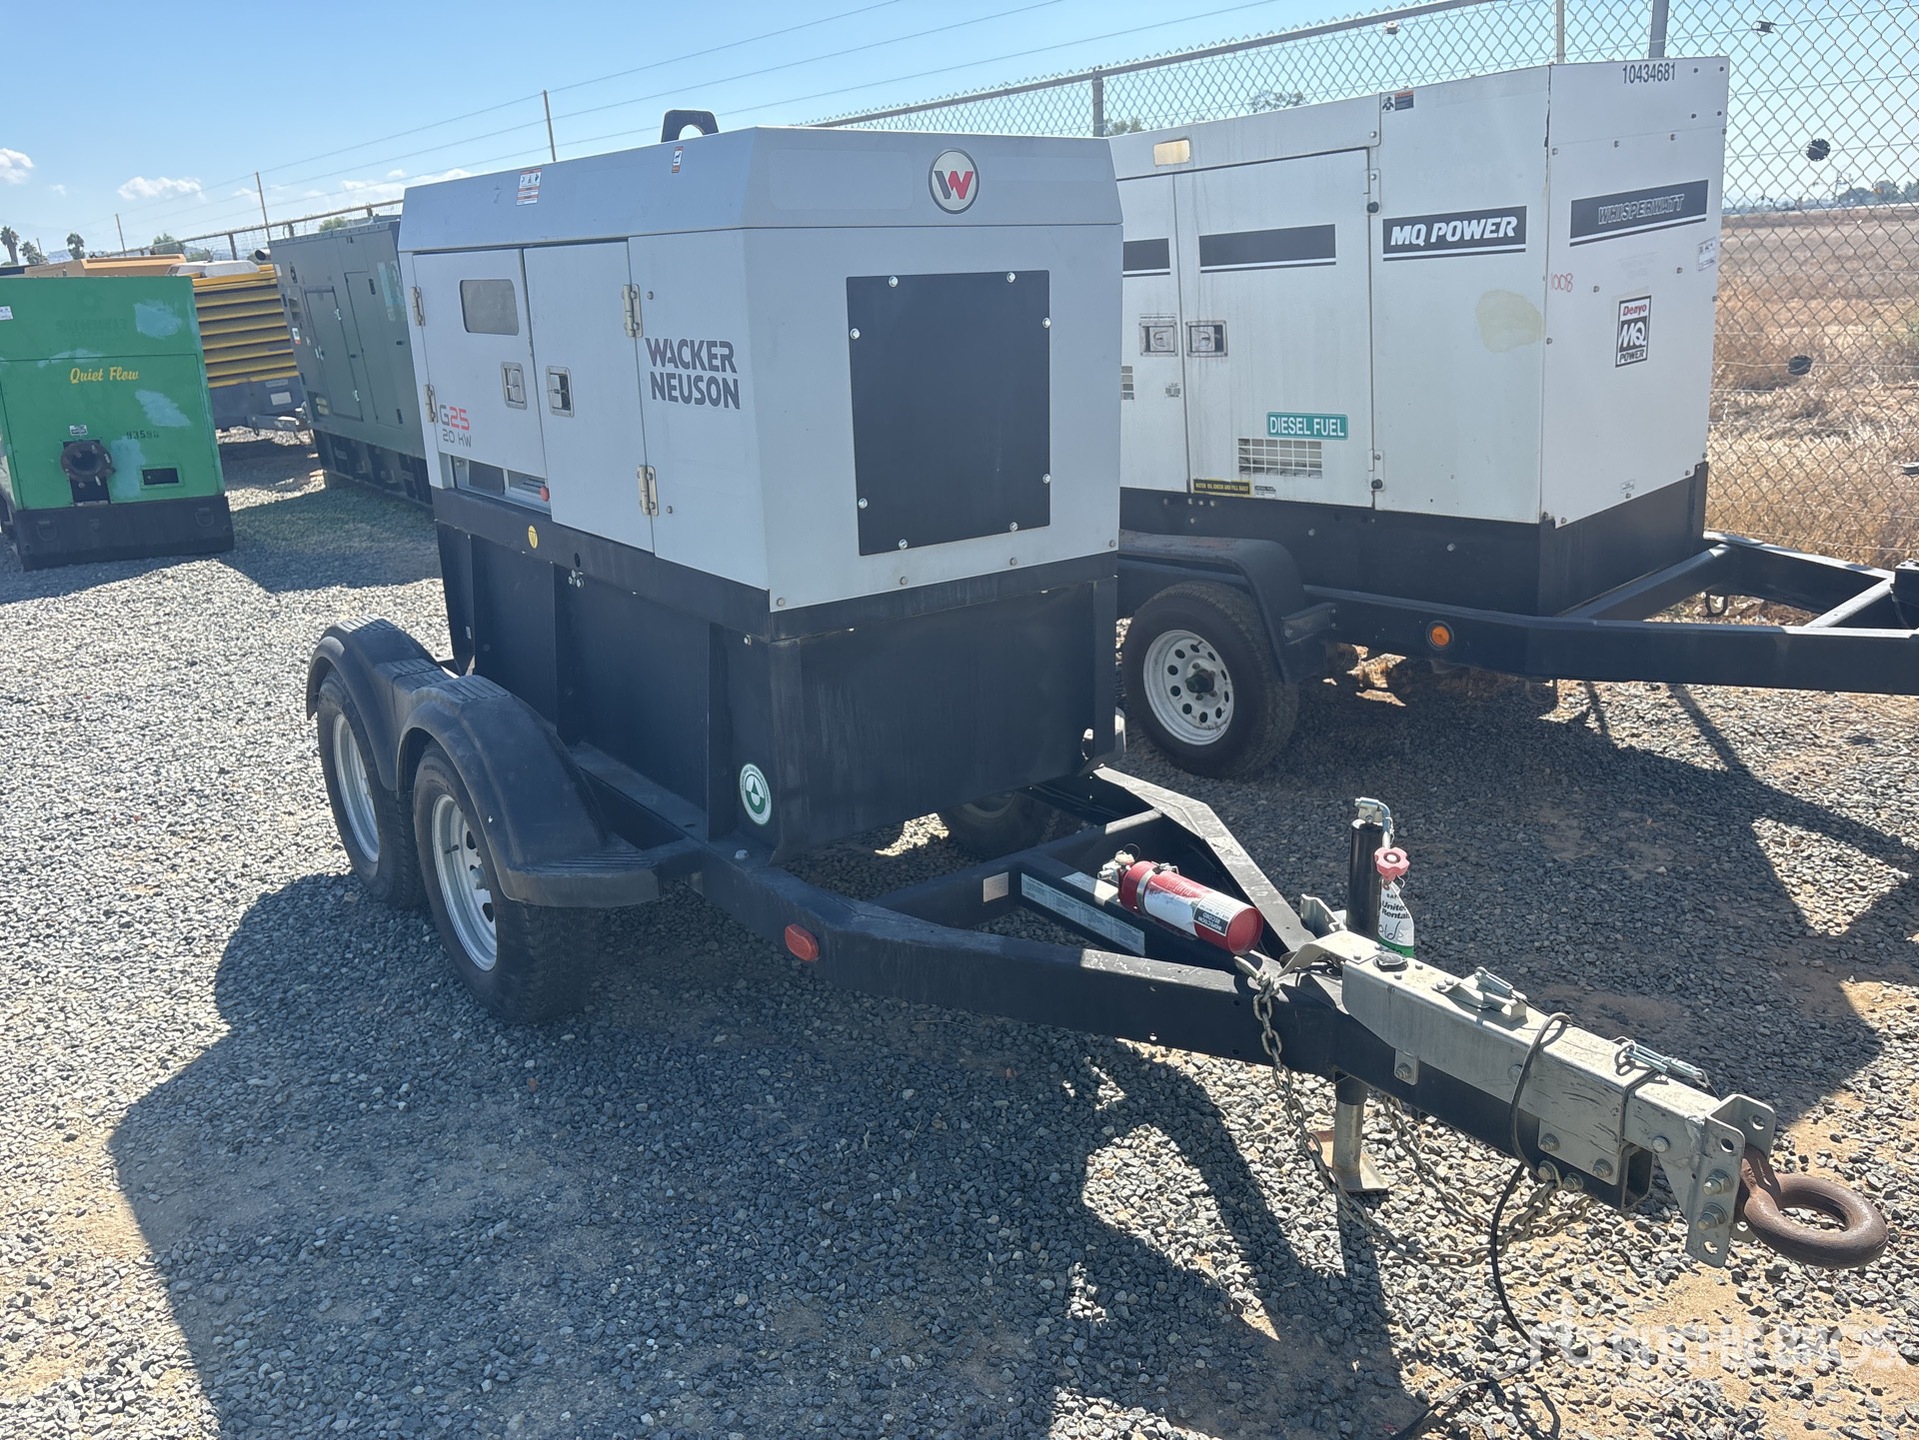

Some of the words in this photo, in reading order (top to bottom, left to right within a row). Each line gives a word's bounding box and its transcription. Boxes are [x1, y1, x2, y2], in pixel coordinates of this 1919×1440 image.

[1622, 62, 1676, 84] 10434681
[1597, 193, 1685, 225] WHISPERWATT
[1390, 223, 1427, 246] MQ
[1430, 216, 1518, 243] POWER
[1622, 304, 1648, 317] Denyo
[1619, 321, 1647, 349] MQ
[645, 337, 738, 374] WACKER
[1619, 348, 1645, 363] POWER
[70, 367, 104, 384] Quiet
[109, 366, 139, 381] Flow
[650, 371, 741, 410] NEUSON
[439, 404, 470, 431] G25
[1269, 416, 1311, 435] DIESEL
[1313, 418, 1345, 436] FUEL
[442, 428, 456, 444] 20
